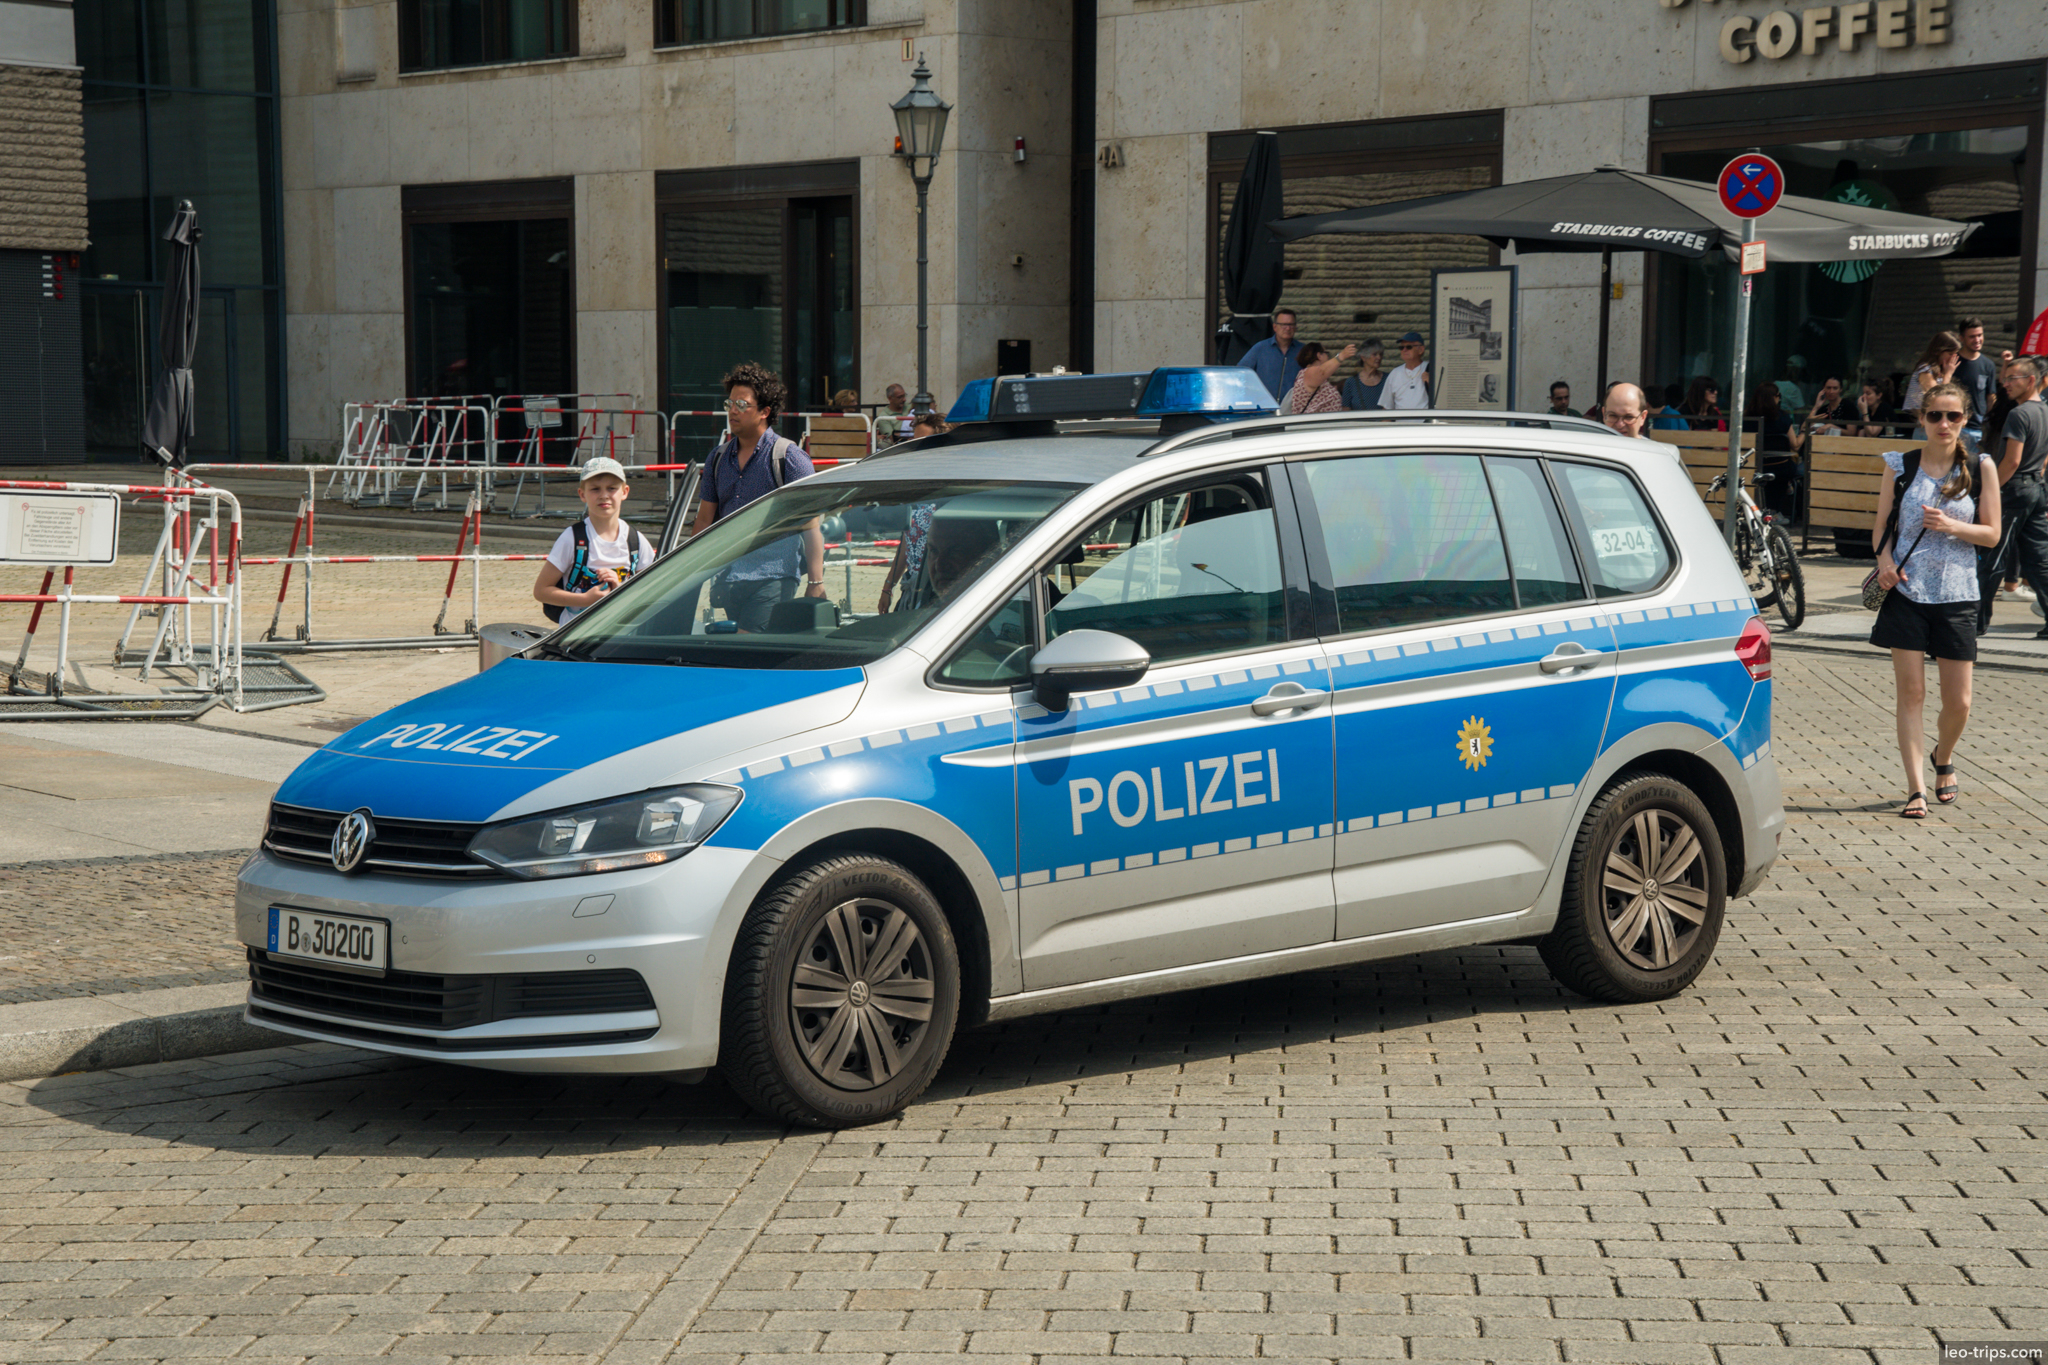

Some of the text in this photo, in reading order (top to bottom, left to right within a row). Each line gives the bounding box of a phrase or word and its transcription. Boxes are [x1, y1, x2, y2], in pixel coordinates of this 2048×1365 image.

[1718, 0, 1948, 64] COFFEE
[1096, 145, 1120, 167] 4A
[1550, 222, 1708, 251] STARBUCKS COFFEE
[1848, 233, 1929, 250] STARBUCKS
[1601, 529, 1646, 553] 32-04
[359, 723, 560, 761] POLIZEI
[1068, 748, 1281, 836] POLIZEI
[1621, 786, 1679, 812] GOODYEAR
[842, 872, 888, 887] VECTOR
[271, 934, 276, 944] D
[288, 915, 373, 961] B 30200
[1676, 953, 1706, 984] VECTOR
